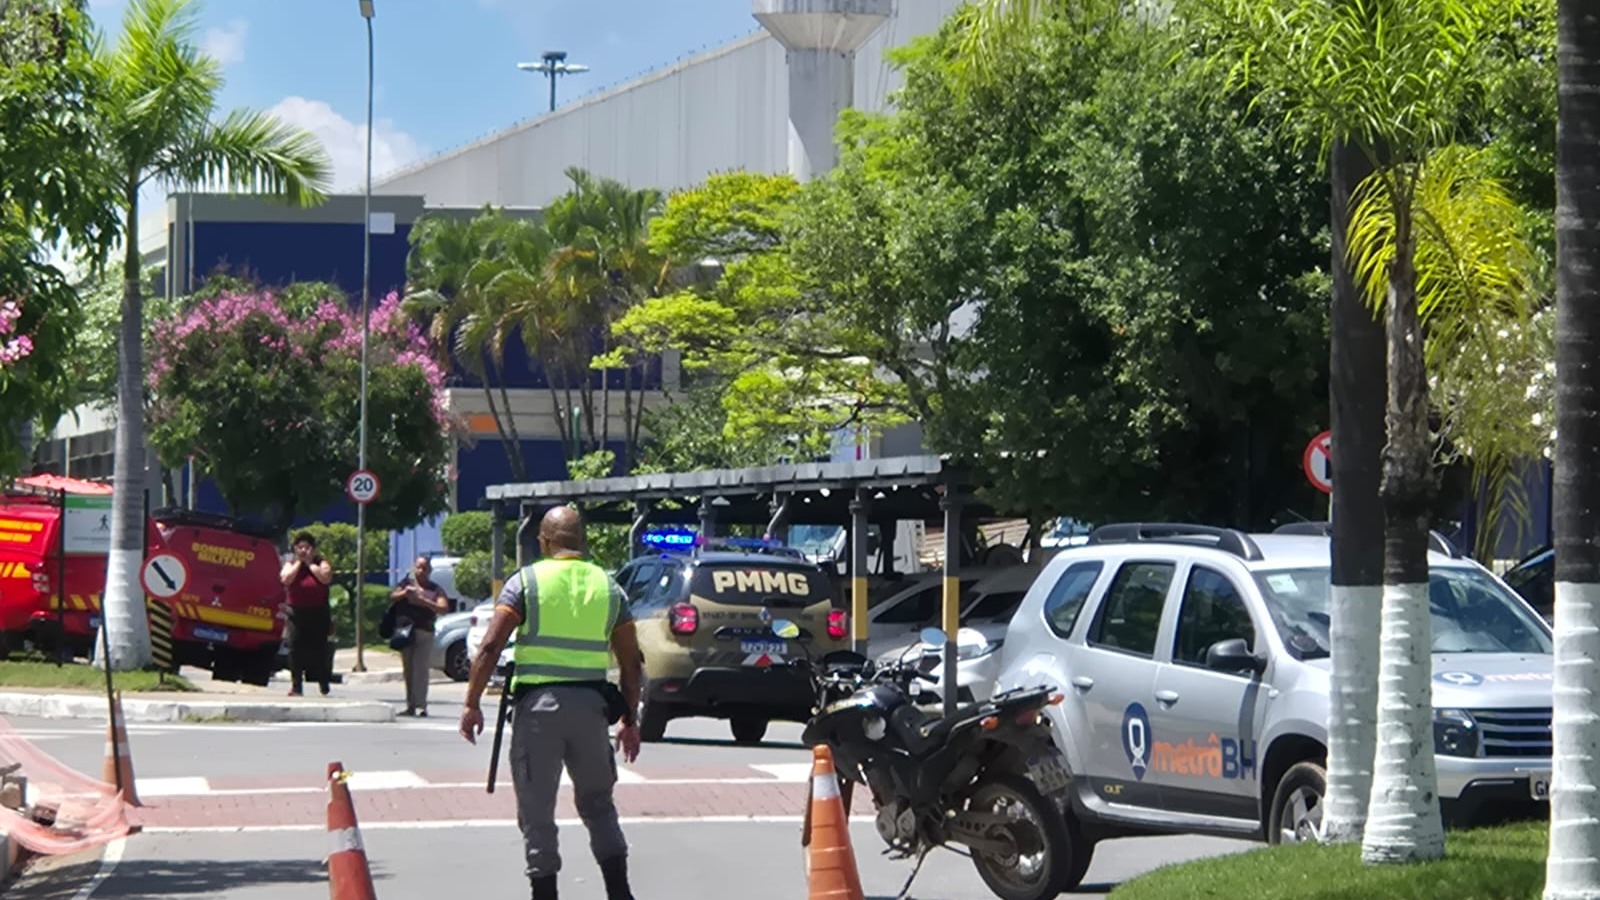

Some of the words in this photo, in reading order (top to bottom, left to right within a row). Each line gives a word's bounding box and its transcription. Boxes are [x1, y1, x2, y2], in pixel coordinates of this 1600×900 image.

[353, 477, 374, 492] 20
[191, 541, 256, 562] BOMBEIRO
[197, 551, 247, 569] MILITAR
[712, 570, 810, 596] PMMG
[1153, 731, 1258, 781] metrôBH
